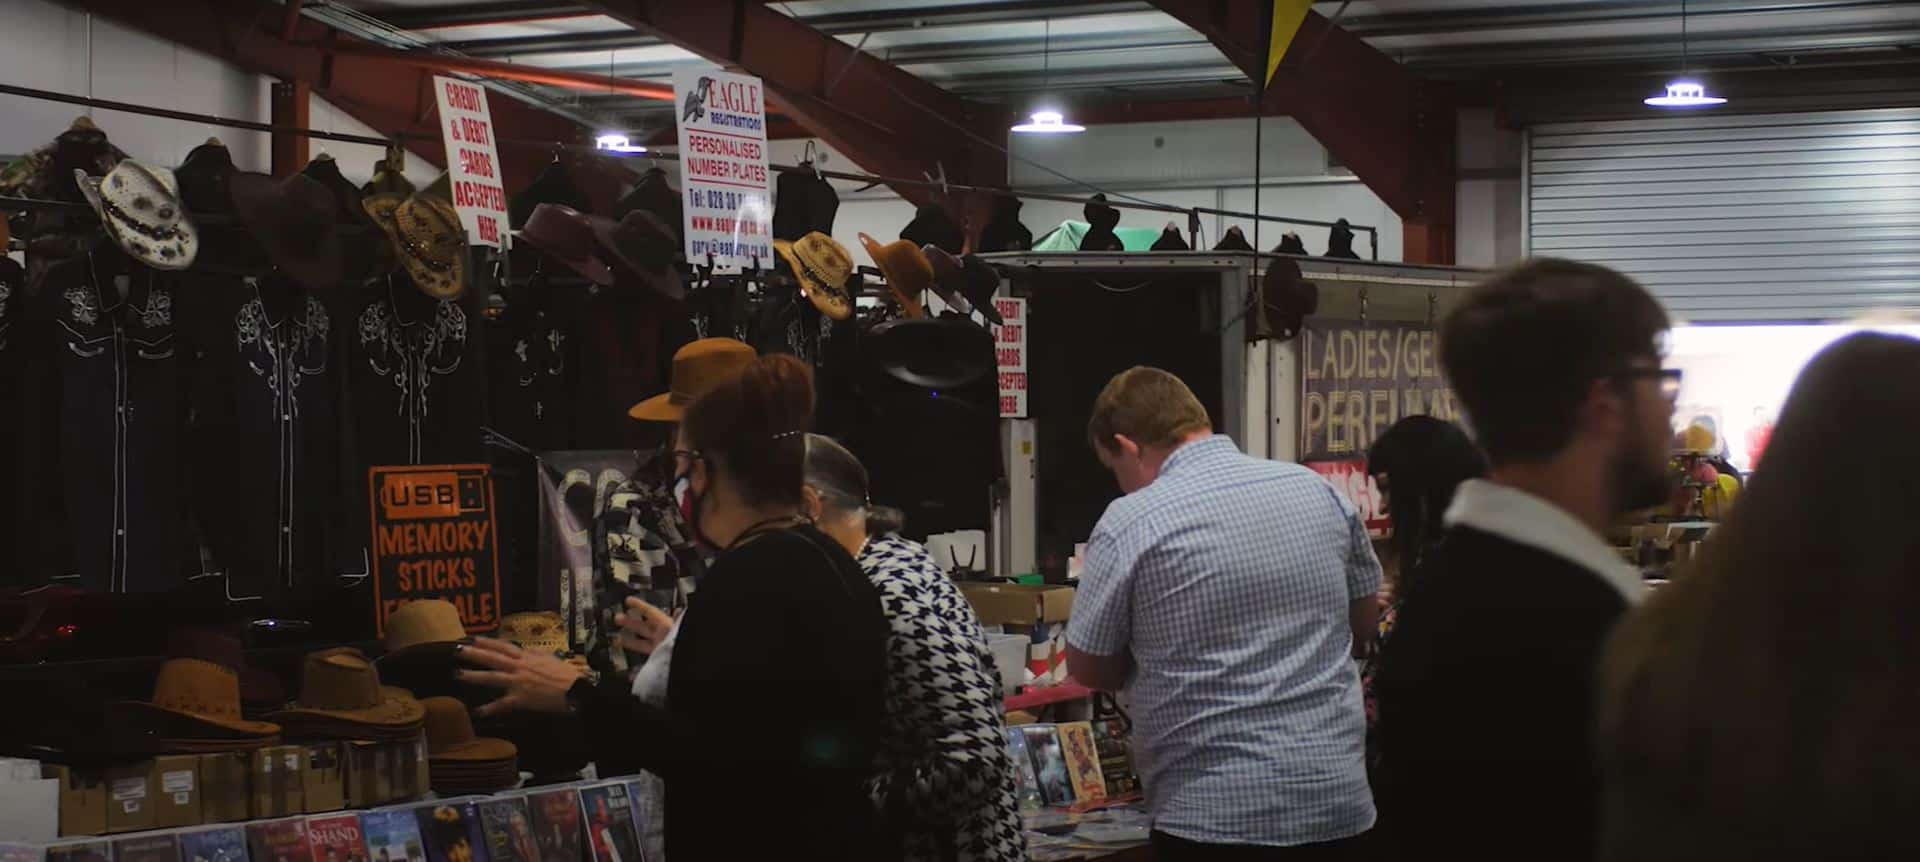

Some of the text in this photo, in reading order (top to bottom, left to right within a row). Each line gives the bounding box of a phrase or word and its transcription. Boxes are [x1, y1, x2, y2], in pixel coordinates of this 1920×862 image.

[445, 82, 482, 113] CREDIT
[709, 78, 760, 115] EAGLE
[451, 116, 490, 145] & DEBIT
[689, 135, 761, 160] PERSONALISED
[459, 148, 494, 179] CARDS
[687, 157, 766, 182] NUMBER PLATES
[455, 181, 506, 212] ACCEPTED
[689, 188, 706, 208] Tel:
[477, 215, 499, 243] HERE
[1002, 325, 1022, 343] DEBIT
[996, 348, 1021, 367] CARDS
[999, 395, 1017, 413] HERE
[391, 483, 454, 507] USB
[378, 521, 489, 556] MEMORY
[398, 558, 477, 592] STICKS
[452, 592, 494, 625] ALE
[308, 826, 358, 845] SHAND
